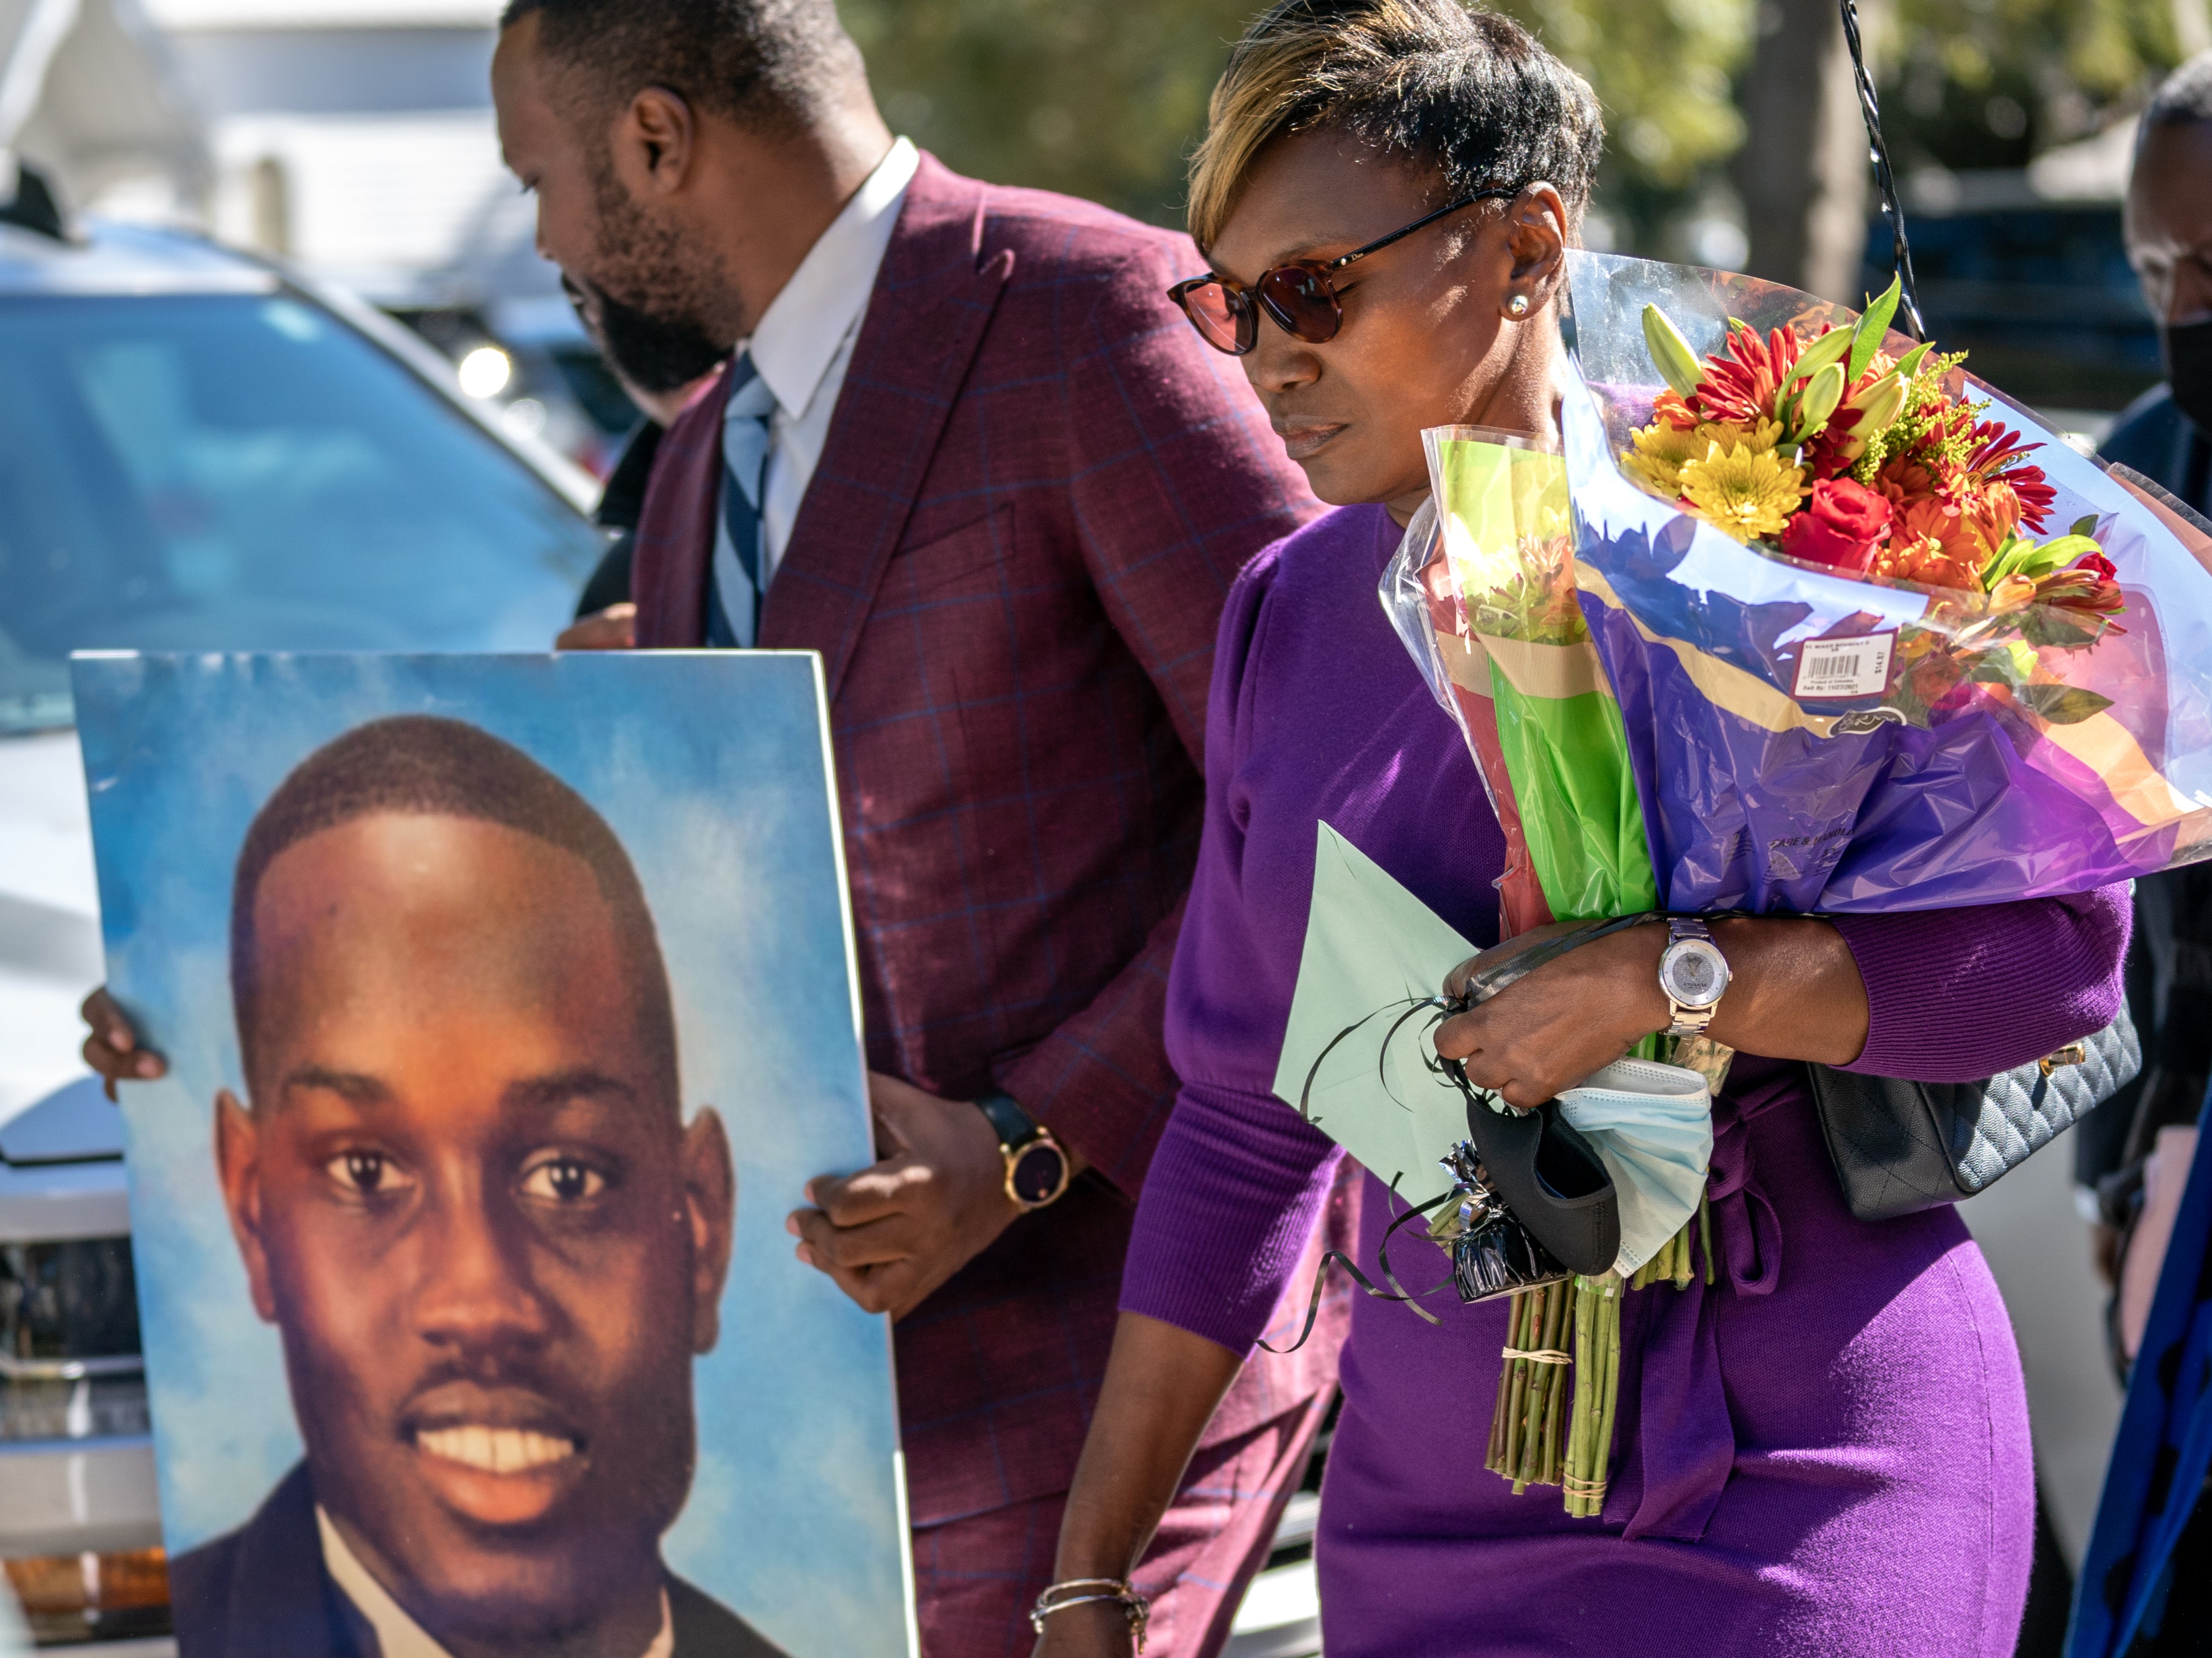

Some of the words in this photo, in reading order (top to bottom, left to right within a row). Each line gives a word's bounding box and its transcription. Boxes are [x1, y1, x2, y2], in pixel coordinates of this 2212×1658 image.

[1351, 252, 1364, 261] Dior
[1874, 652, 1885, 674] $14.87
[1771, 837, 1801, 849] CARE
[1801, 836, 1811, 845] &
